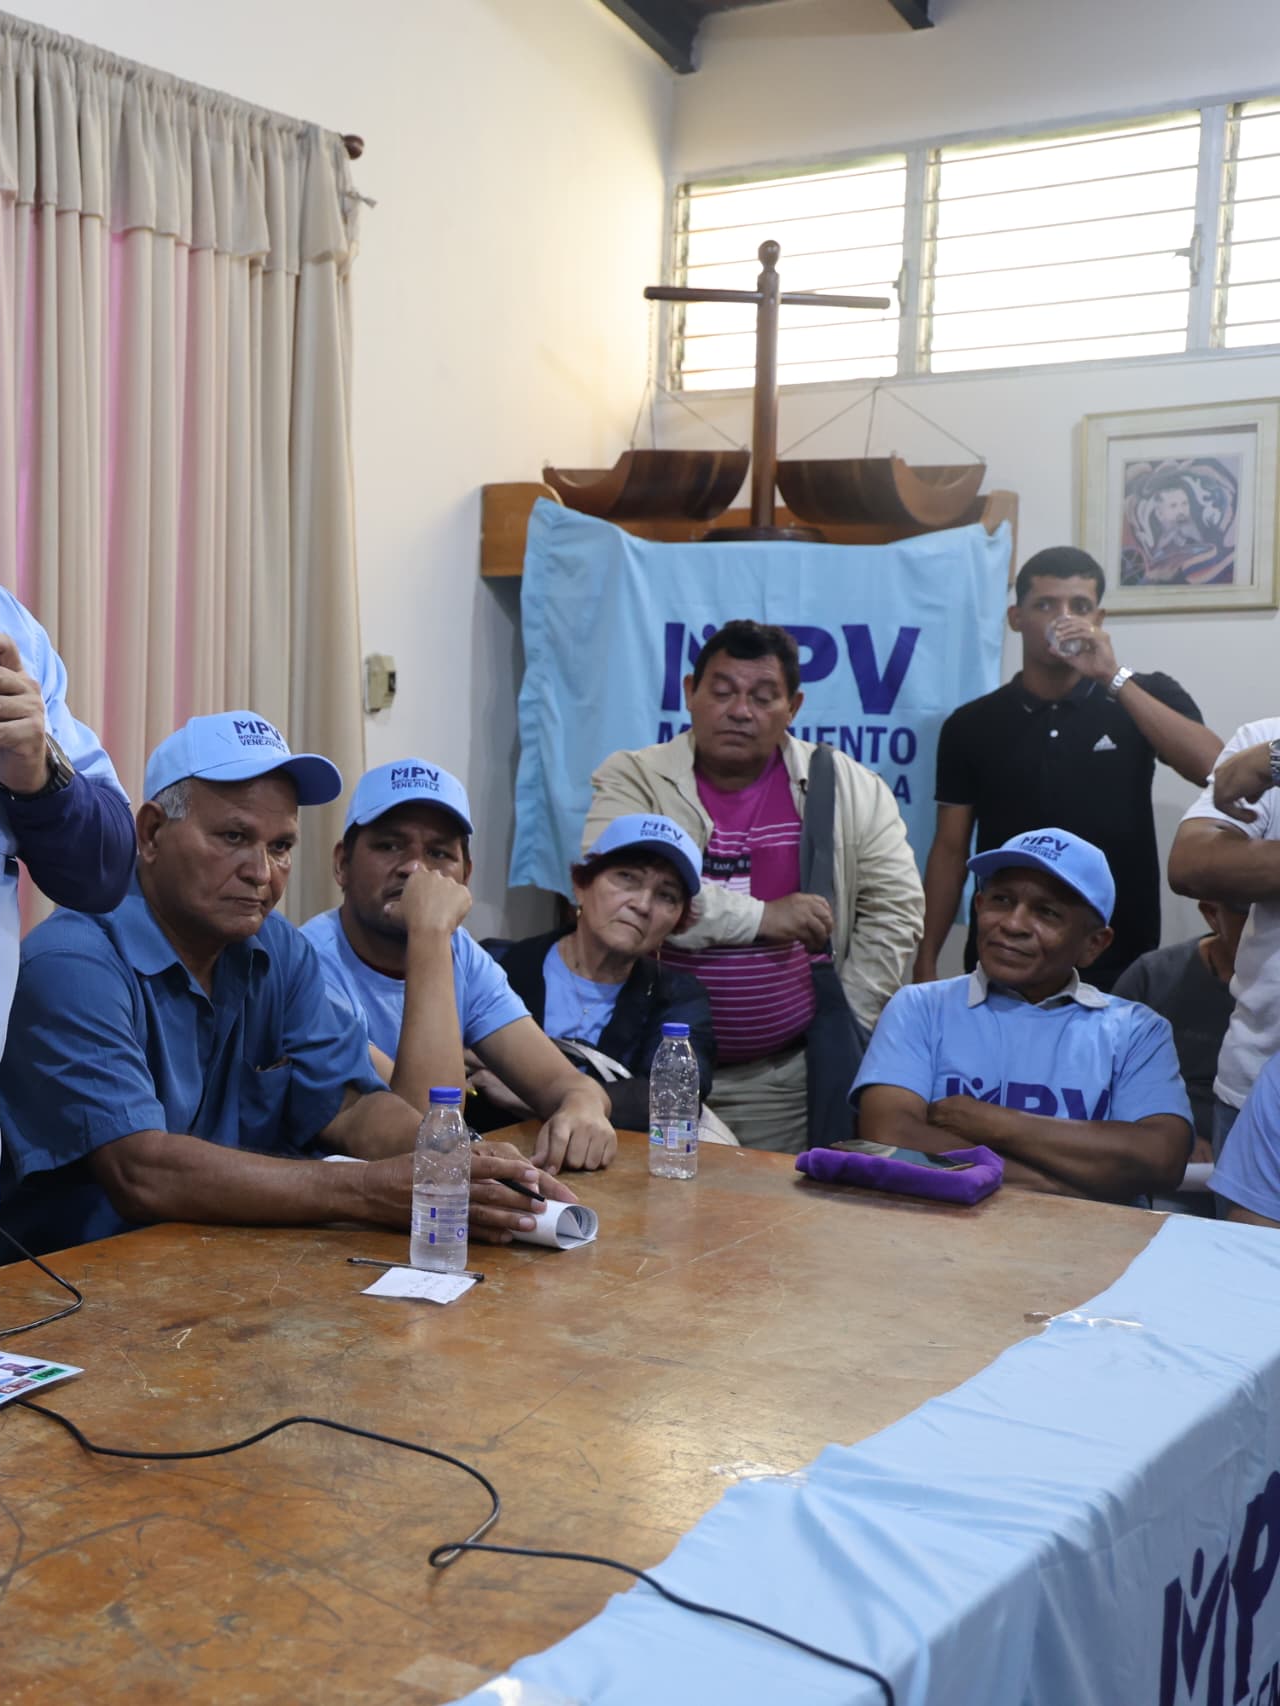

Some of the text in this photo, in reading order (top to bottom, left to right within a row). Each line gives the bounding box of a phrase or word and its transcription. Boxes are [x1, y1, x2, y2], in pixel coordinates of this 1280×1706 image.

[233, 720, 282, 741] MPV
[391, 766, 439, 782] MPV
[1021, 836, 1070, 852] MPV
